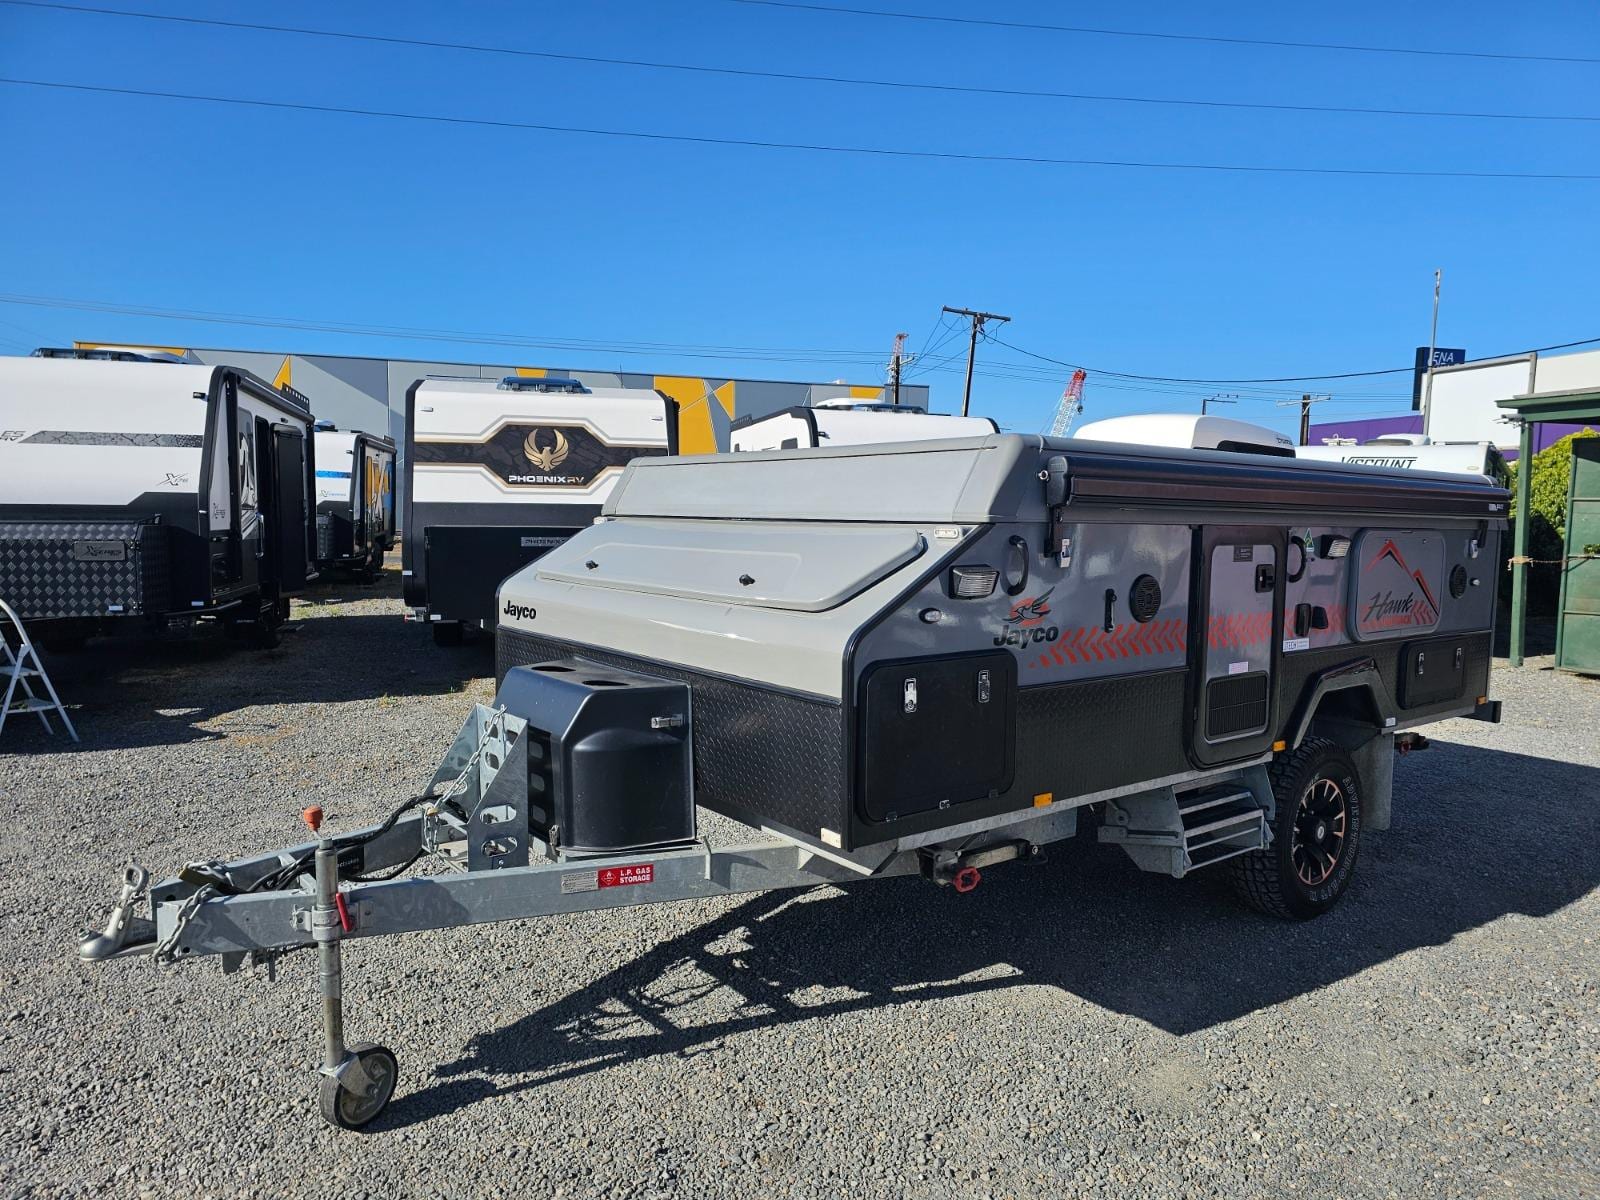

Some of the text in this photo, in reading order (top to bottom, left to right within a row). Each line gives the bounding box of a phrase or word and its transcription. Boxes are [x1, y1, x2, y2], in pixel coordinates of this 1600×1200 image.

[508, 475, 566, 484] PHOENIX
[503, 600, 537, 621] Jayco
[1363, 590, 1413, 622] Hawk
[993, 624, 1059, 649] Jayco
[635, 866, 651, 875] GAS
[619, 874, 651, 884] STORAGE
